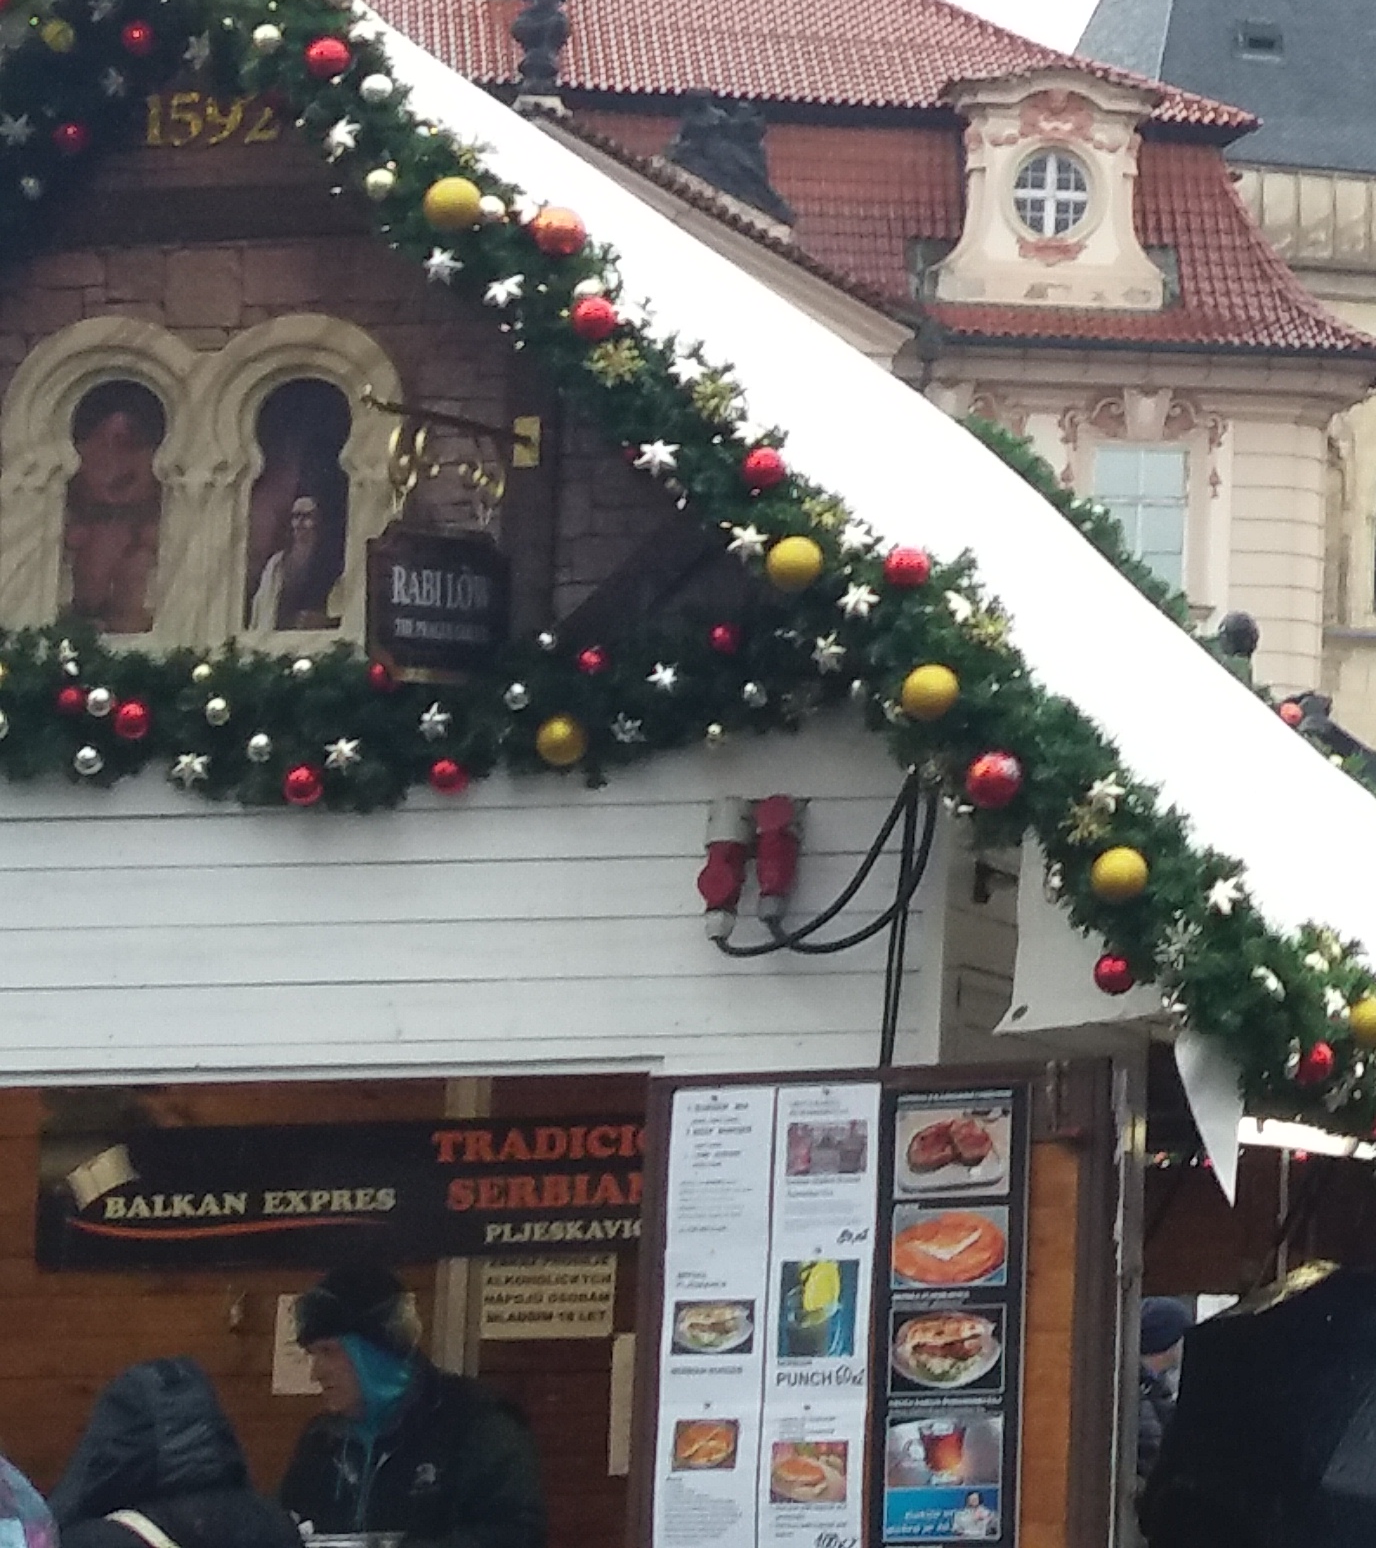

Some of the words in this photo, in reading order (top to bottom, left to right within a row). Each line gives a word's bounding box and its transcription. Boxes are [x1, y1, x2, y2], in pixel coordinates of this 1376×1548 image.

[146, 92, 279, 147] 1592
[391, 565, 441, 607] RABI
[103, 1192, 248, 1220] BALKAN
[262, 1187, 397, 1214] EXPRES
[577, 1309, 607, 1322] LET
[776, 1372, 832, 1387] PUNCH
